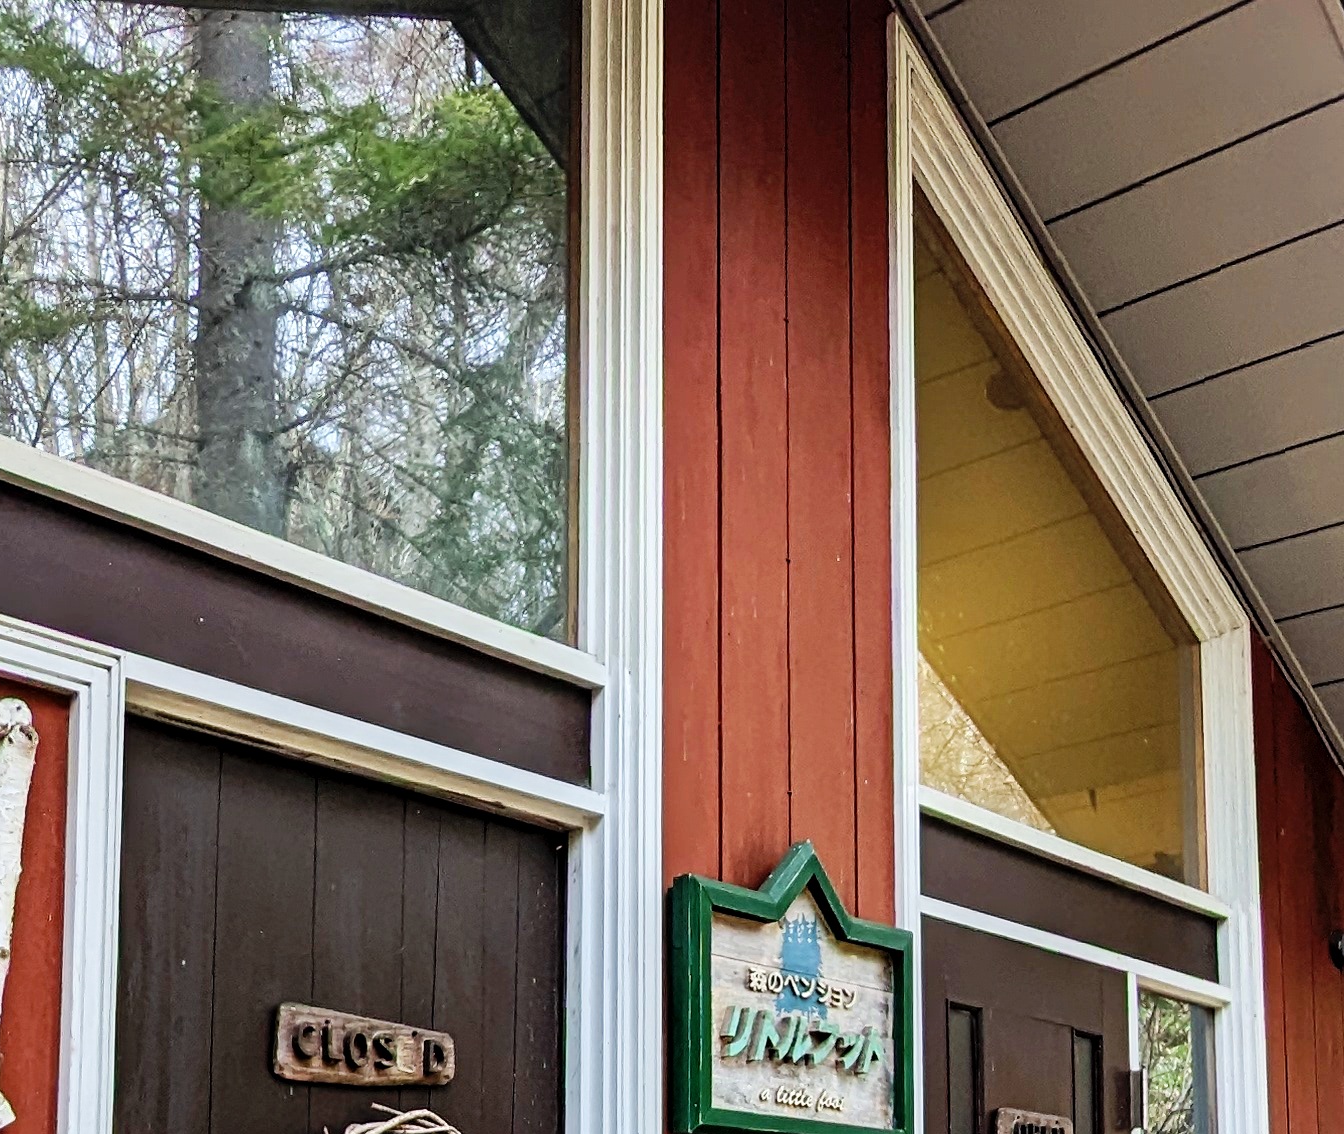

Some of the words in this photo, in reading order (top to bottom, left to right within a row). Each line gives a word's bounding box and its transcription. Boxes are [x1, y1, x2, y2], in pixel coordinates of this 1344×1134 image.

[748, 967, 857, 1009] 森のペンション
[291, 1020, 448, 1076] CLOSD
[720, 1005, 885, 1074] リトルフット
[760, 1088, 771, 1102] a
[776, 1085, 813, 1108] little
